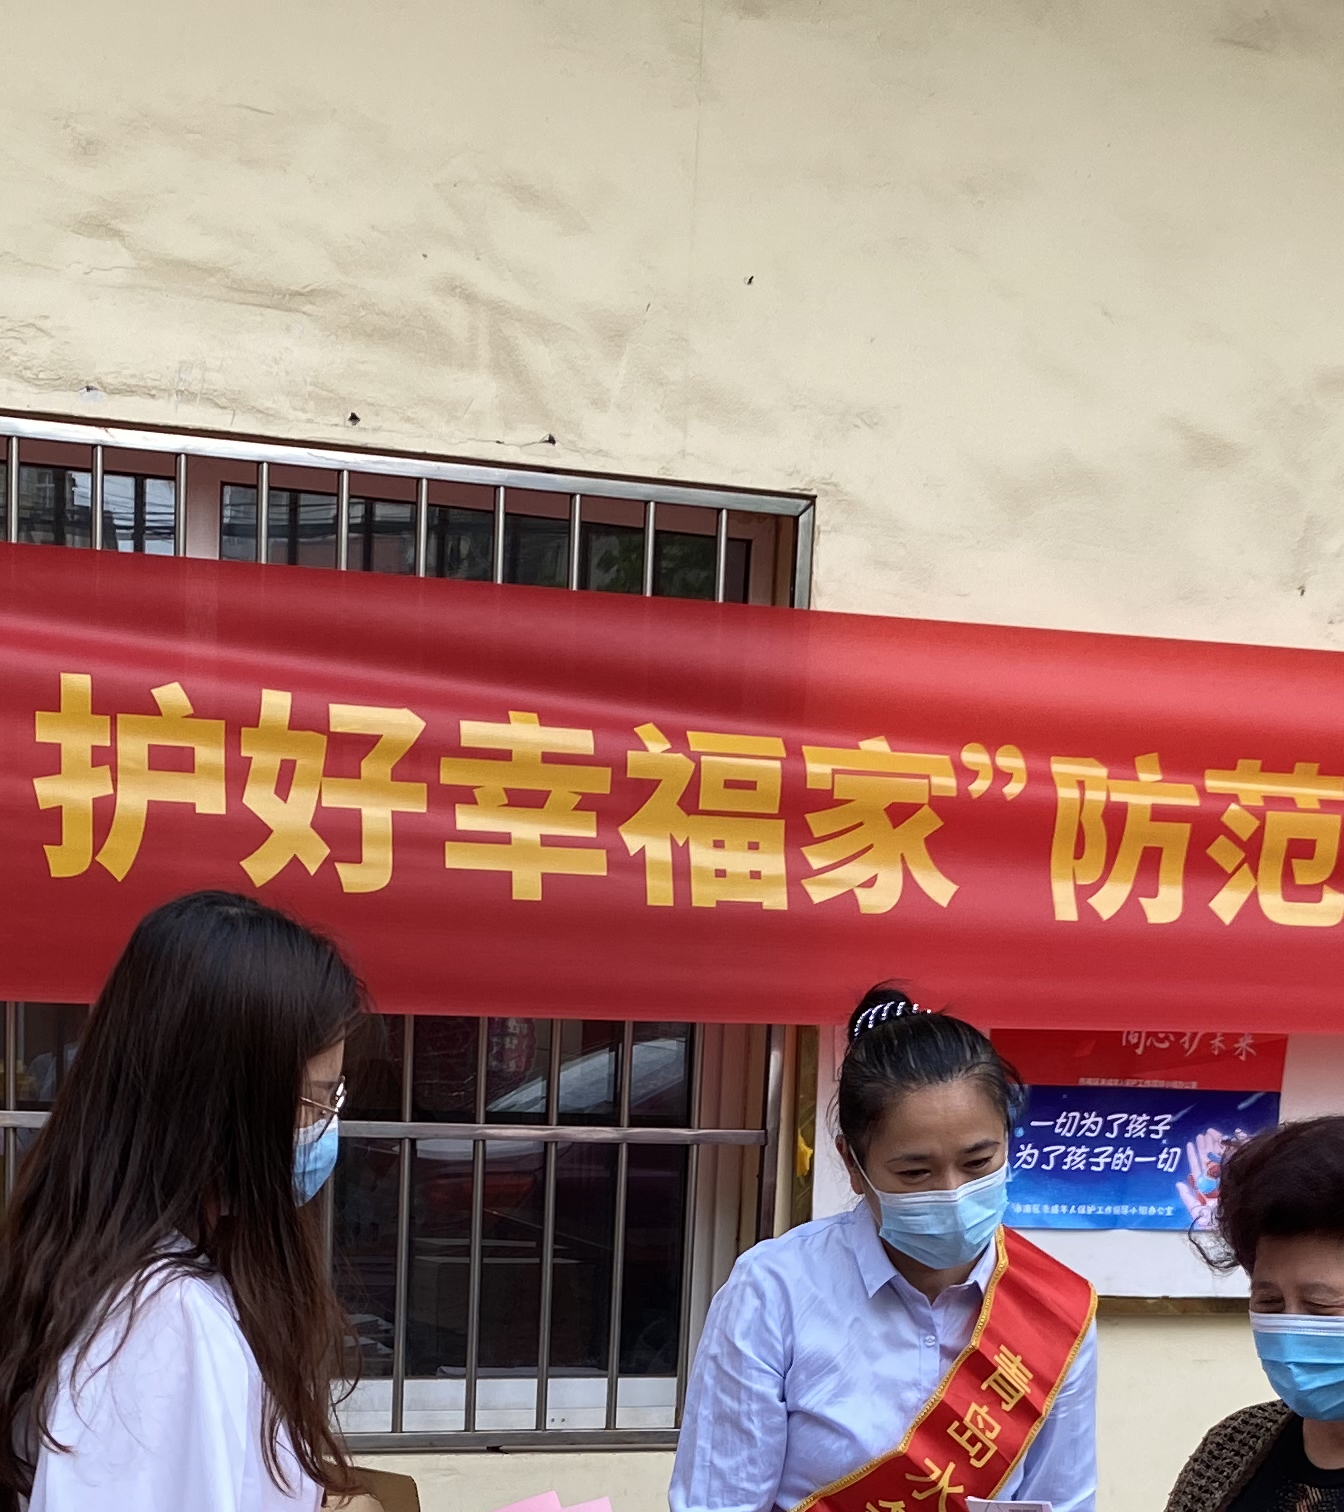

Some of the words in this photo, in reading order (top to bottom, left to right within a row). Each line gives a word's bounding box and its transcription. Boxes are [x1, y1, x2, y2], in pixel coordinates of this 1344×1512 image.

[1031, 1112, 1173, 1139] 一切为了孩子
[1013, 1143, 1181, 1173] 为了孩子的一切
